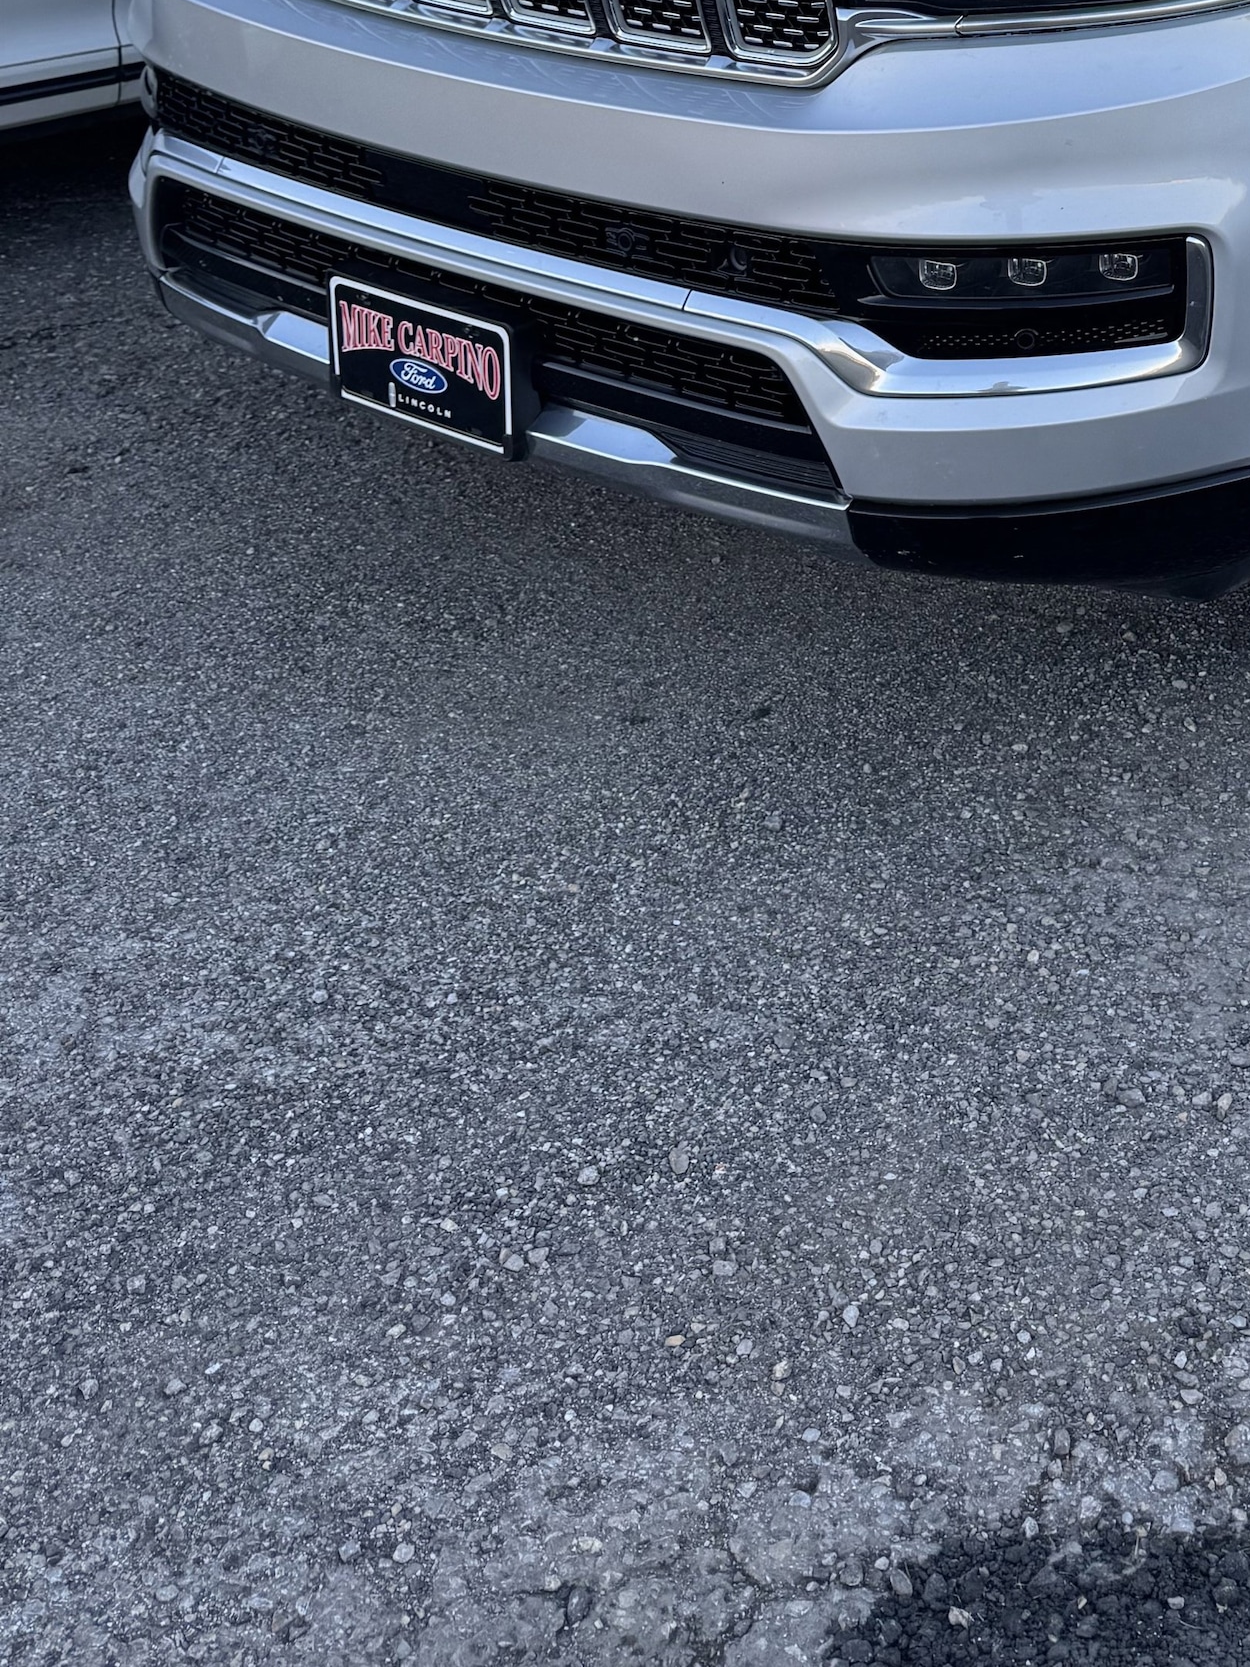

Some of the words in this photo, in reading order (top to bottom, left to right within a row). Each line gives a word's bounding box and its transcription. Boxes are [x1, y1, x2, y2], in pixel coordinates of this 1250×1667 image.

[339, 300, 394, 352] MIKE
[397, 320, 501, 401] CARPINO
[400, 361, 436, 390] Ford
[398, 393, 452, 419] LINCOLN
